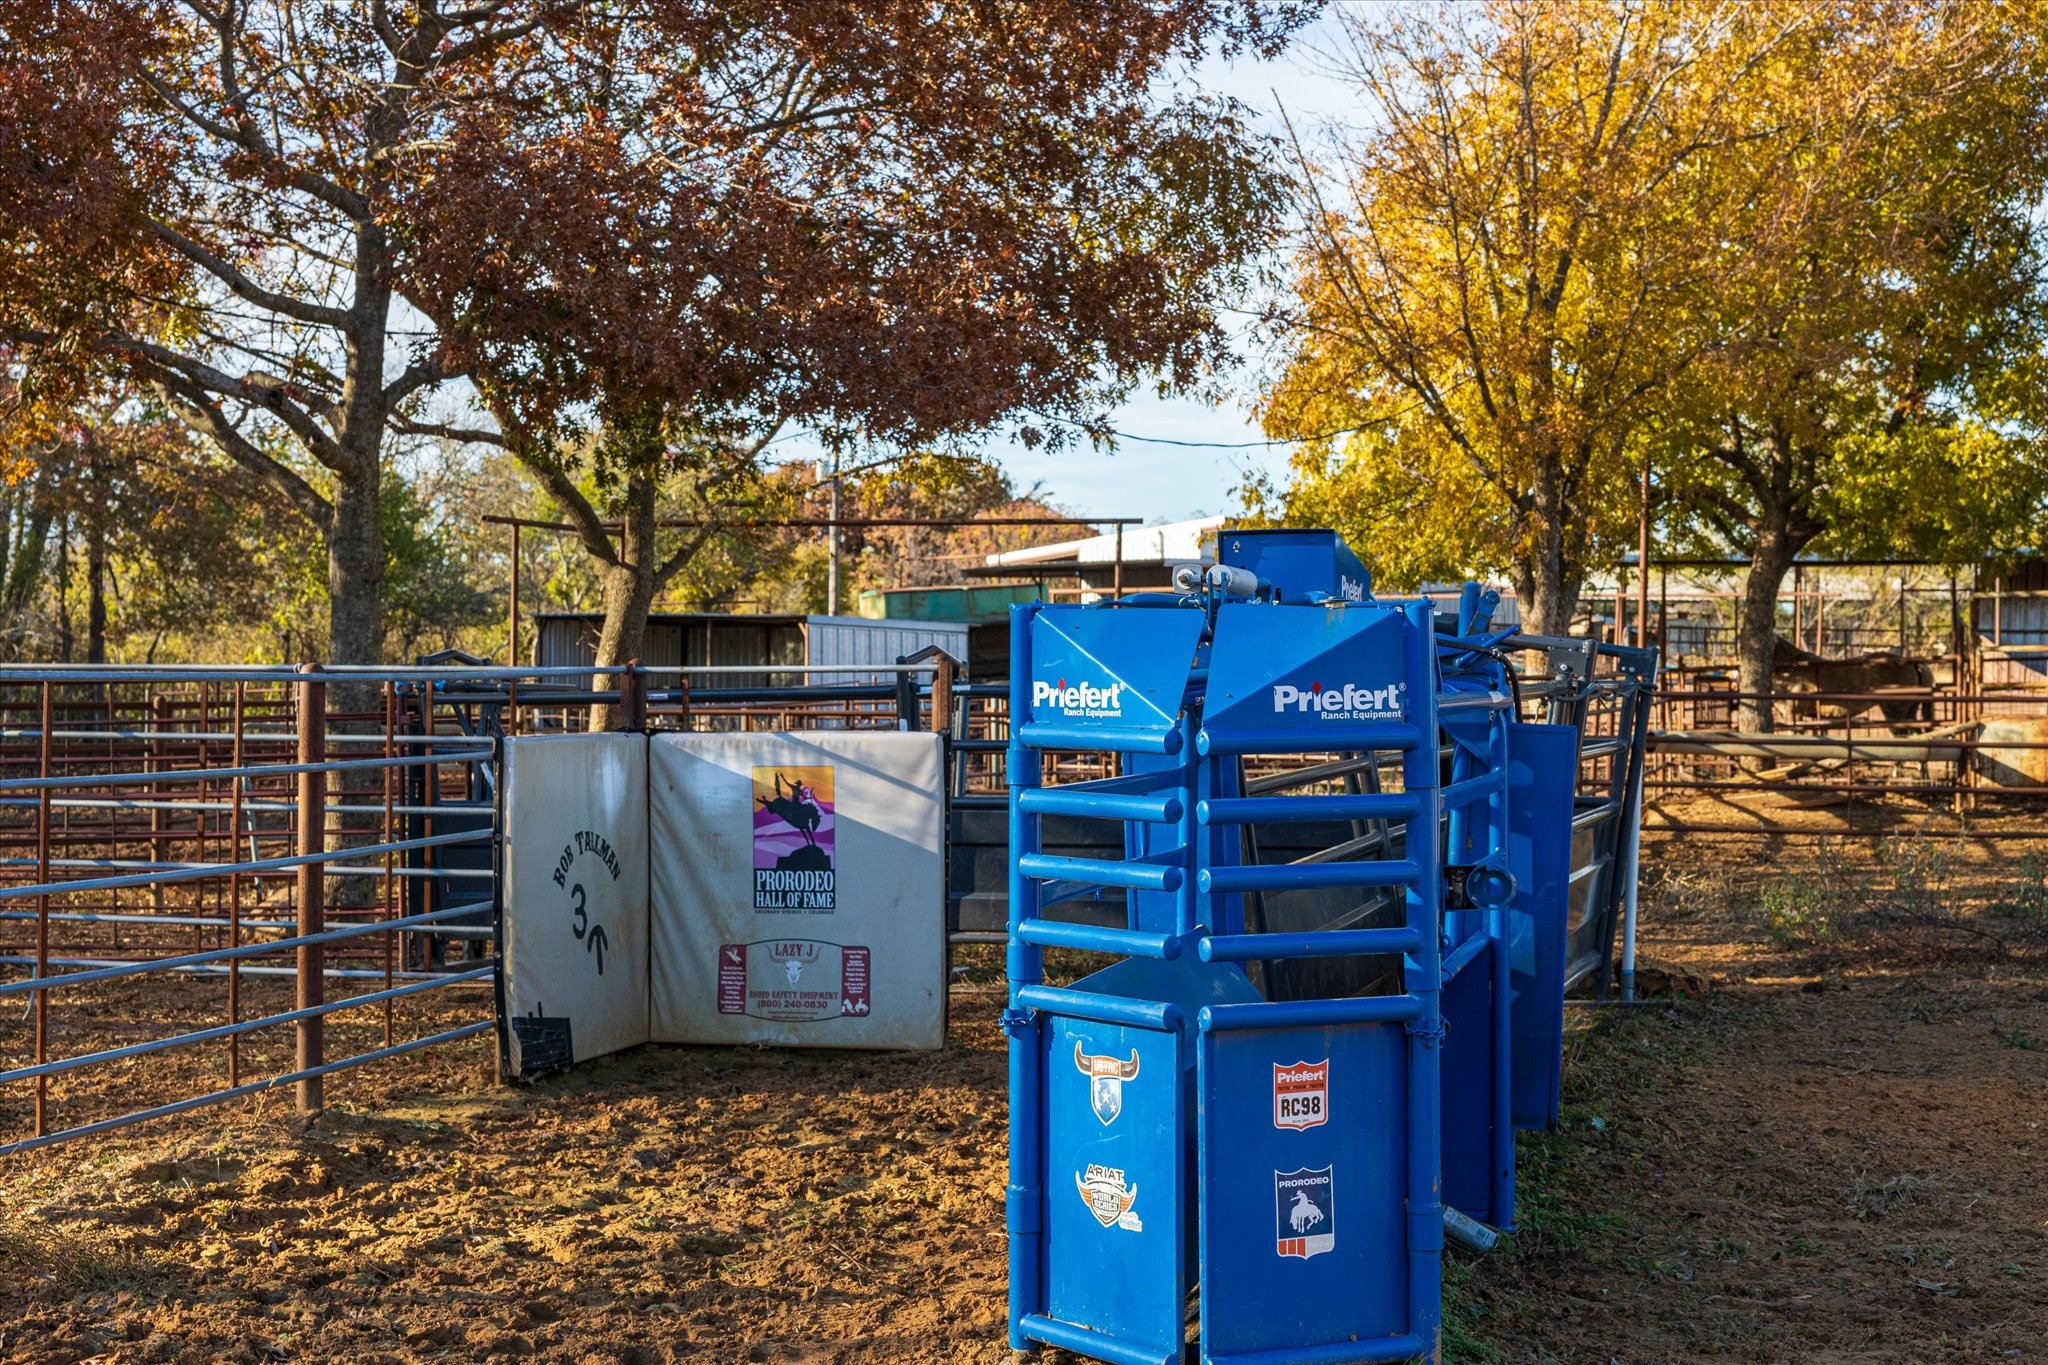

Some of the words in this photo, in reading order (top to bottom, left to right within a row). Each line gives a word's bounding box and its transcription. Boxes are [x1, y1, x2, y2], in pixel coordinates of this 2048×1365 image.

[1063, 707, 1085, 717] Ranch
[1086, 708, 1122, 719] Equipment
[1321, 711, 1350, 720] Ranch
[1352, 710, 1402, 721] Equipment
[553, 844, 574, 890] BOB
[575, 831, 621, 882] TALLMAN
[755, 870, 834, 892] PRORODEO
[755, 891, 786, 908] HALL
[786, 891, 802, 908] OF
[803, 892, 834, 909] FAME
[571, 883, 588, 940] 3
[774, 943, 803, 957] LAZY
[806, 943, 814, 957] J
[771, 991, 798, 1000] SAFETY
[799, 991, 840, 1000] EQUIPMENT
[757, 1000, 781, 1009] (800)
[784, 1000, 828, 1009] 240-0830
[1277, 1069, 1324, 1084] Priefert
[1281, 1095, 1321, 1117] RC98
[1087, 1165, 1123, 1181] ARIAT
[1278, 1176, 1330, 1189] PRORODEO
[1092, 1191, 1119, 1204] WORLD
[1093, 1199, 1119, 1211] SERIES
